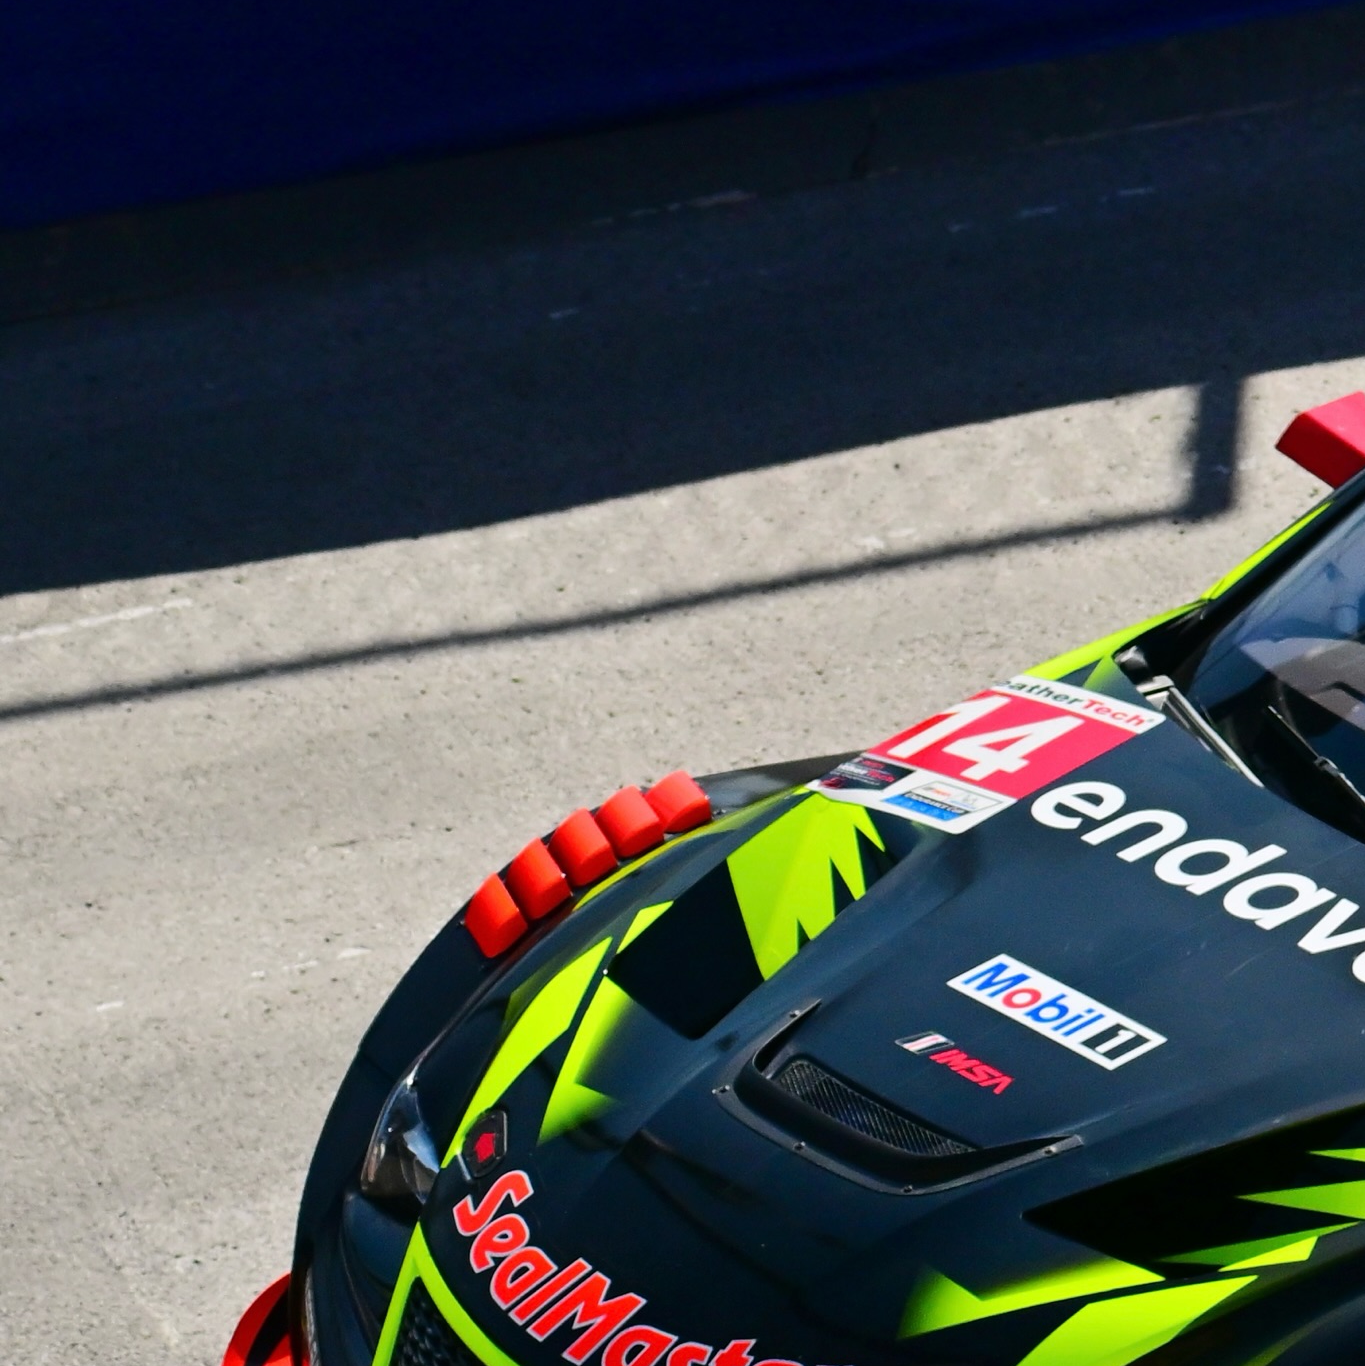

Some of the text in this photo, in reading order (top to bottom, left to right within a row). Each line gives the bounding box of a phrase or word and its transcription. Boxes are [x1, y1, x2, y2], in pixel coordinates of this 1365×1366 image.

[1001, 680, 1144, 727] atherTech
[886, 695, 1086, 782] 14
[962, 963, 1140, 1054] Mobil 1
[929, 1049, 1015, 1095] IMSA
